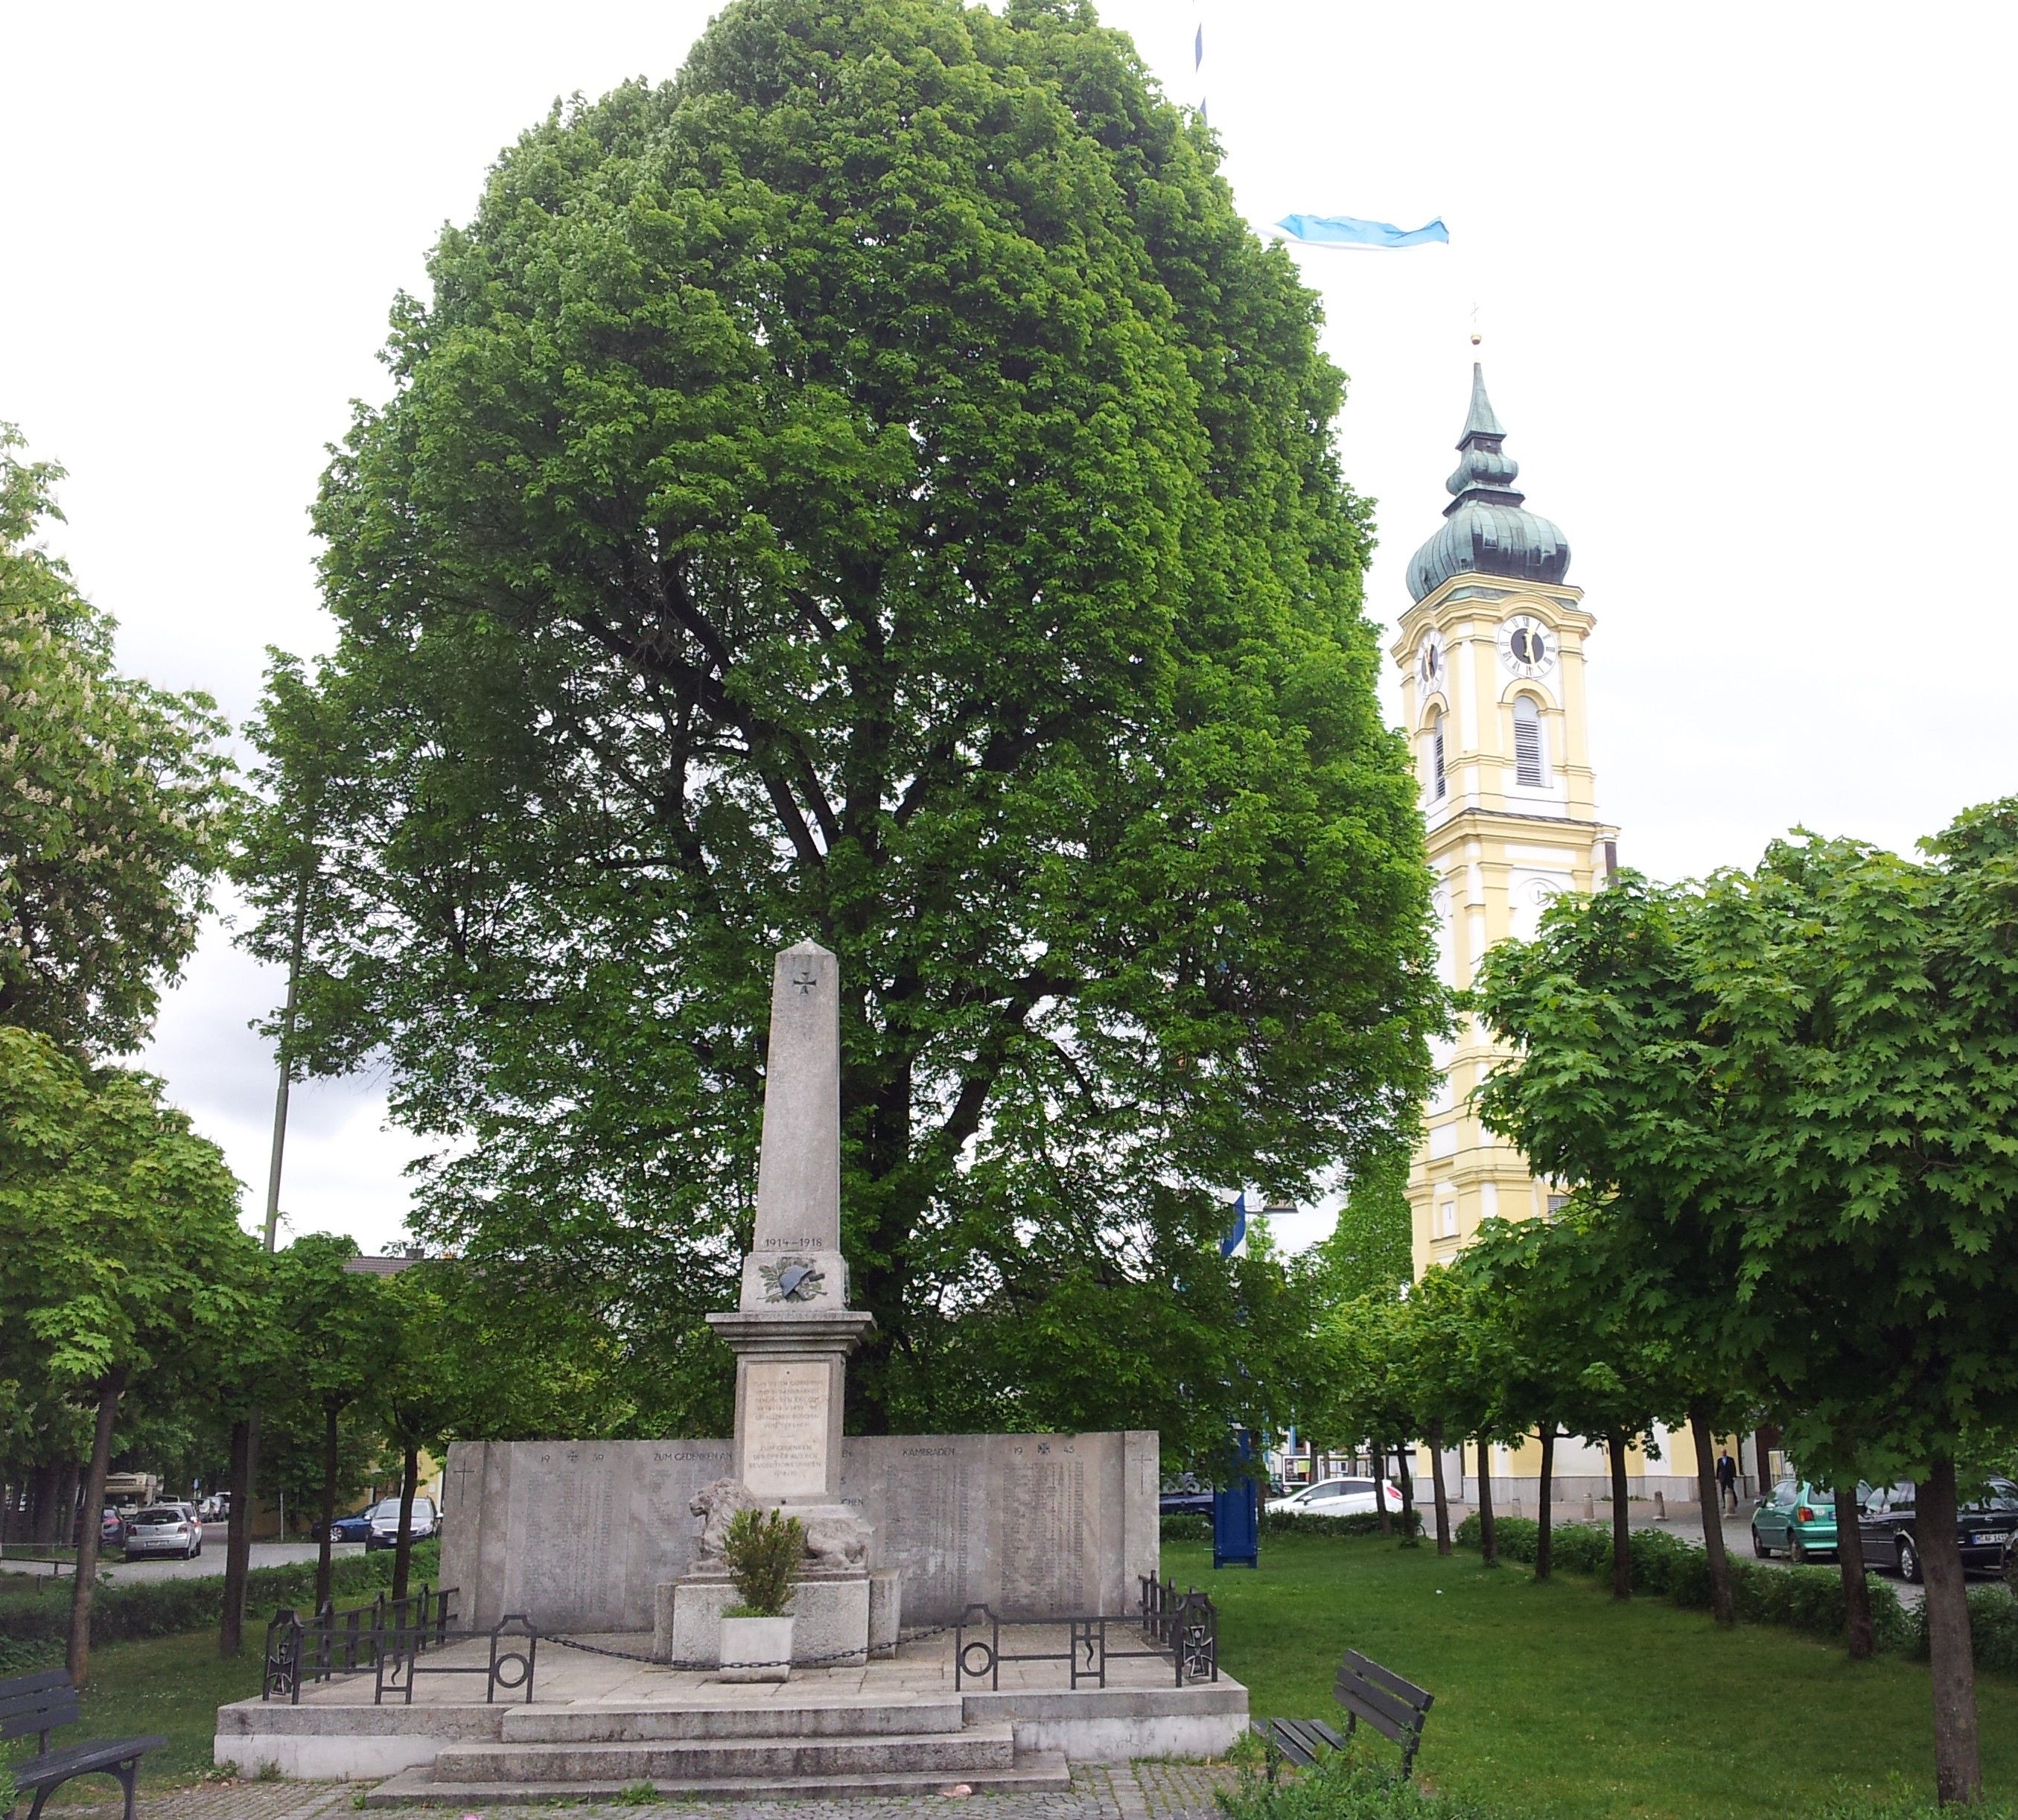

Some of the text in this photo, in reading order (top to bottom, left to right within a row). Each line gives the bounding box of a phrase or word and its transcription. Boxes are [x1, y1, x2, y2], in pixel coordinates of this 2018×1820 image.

[654, 1453, 672, 1461] ZUM
[674, 1452, 718, 1461] GEDENKEN
[903, 1448, 955, 1457] KAMERADEN
[1014, 1445, 1075, 1455] 19 45
